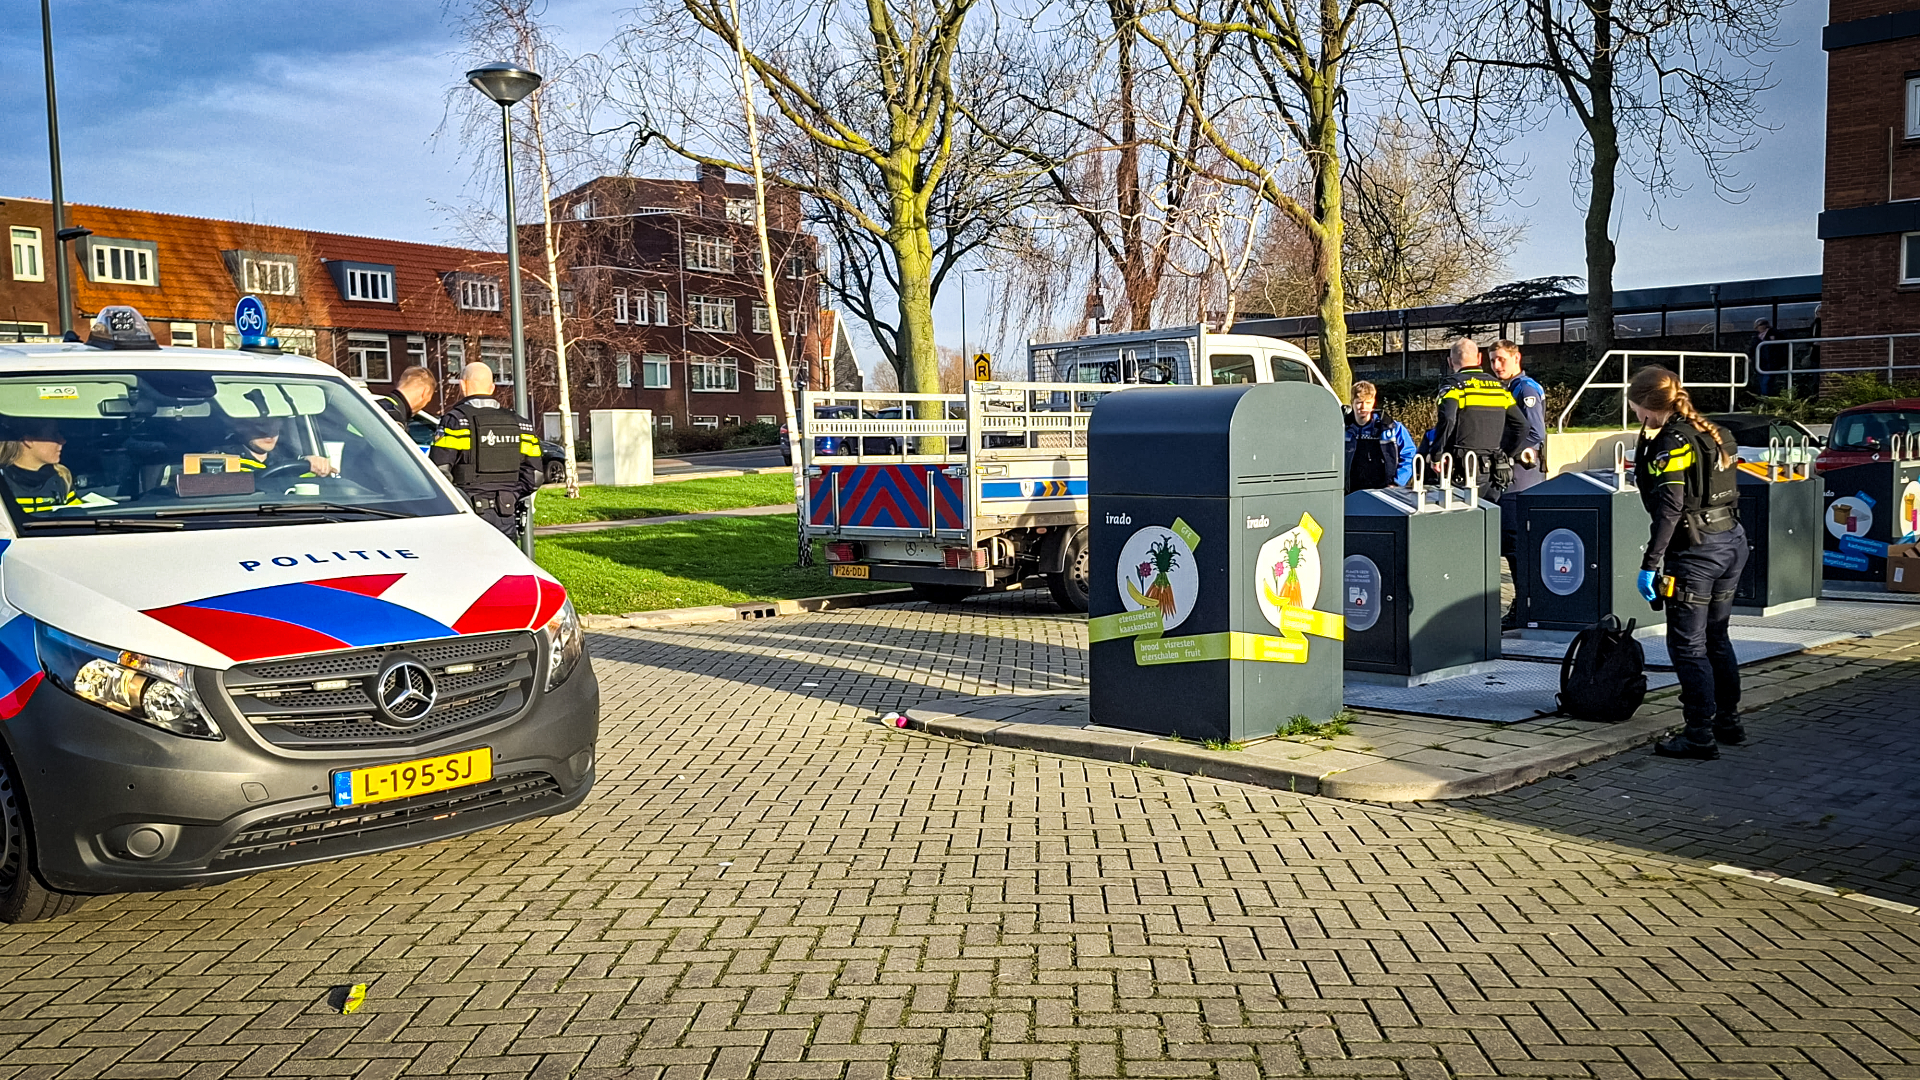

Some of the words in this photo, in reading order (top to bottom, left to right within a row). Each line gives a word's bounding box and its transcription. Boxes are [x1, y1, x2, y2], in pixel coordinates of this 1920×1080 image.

[978, 365, 987, 377] R
[1105, 512, 1132, 525] irado
[1246, 514, 1271, 529] irado
[238, 549, 420, 572] POLITIE
[1118, 610, 1157, 624] etensresten
[1119, 621, 1159, 634] kaaskorsten
[1140, 641, 1160, 652] brood
[1163, 639, 1196, 649] visresten
[1141, 650, 1179, 661] eierschalen
[1184, 648, 1202, 658] fruit
[364, 755, 473, 797] L-195-SJ
[338, 791, 351, 800] NL
